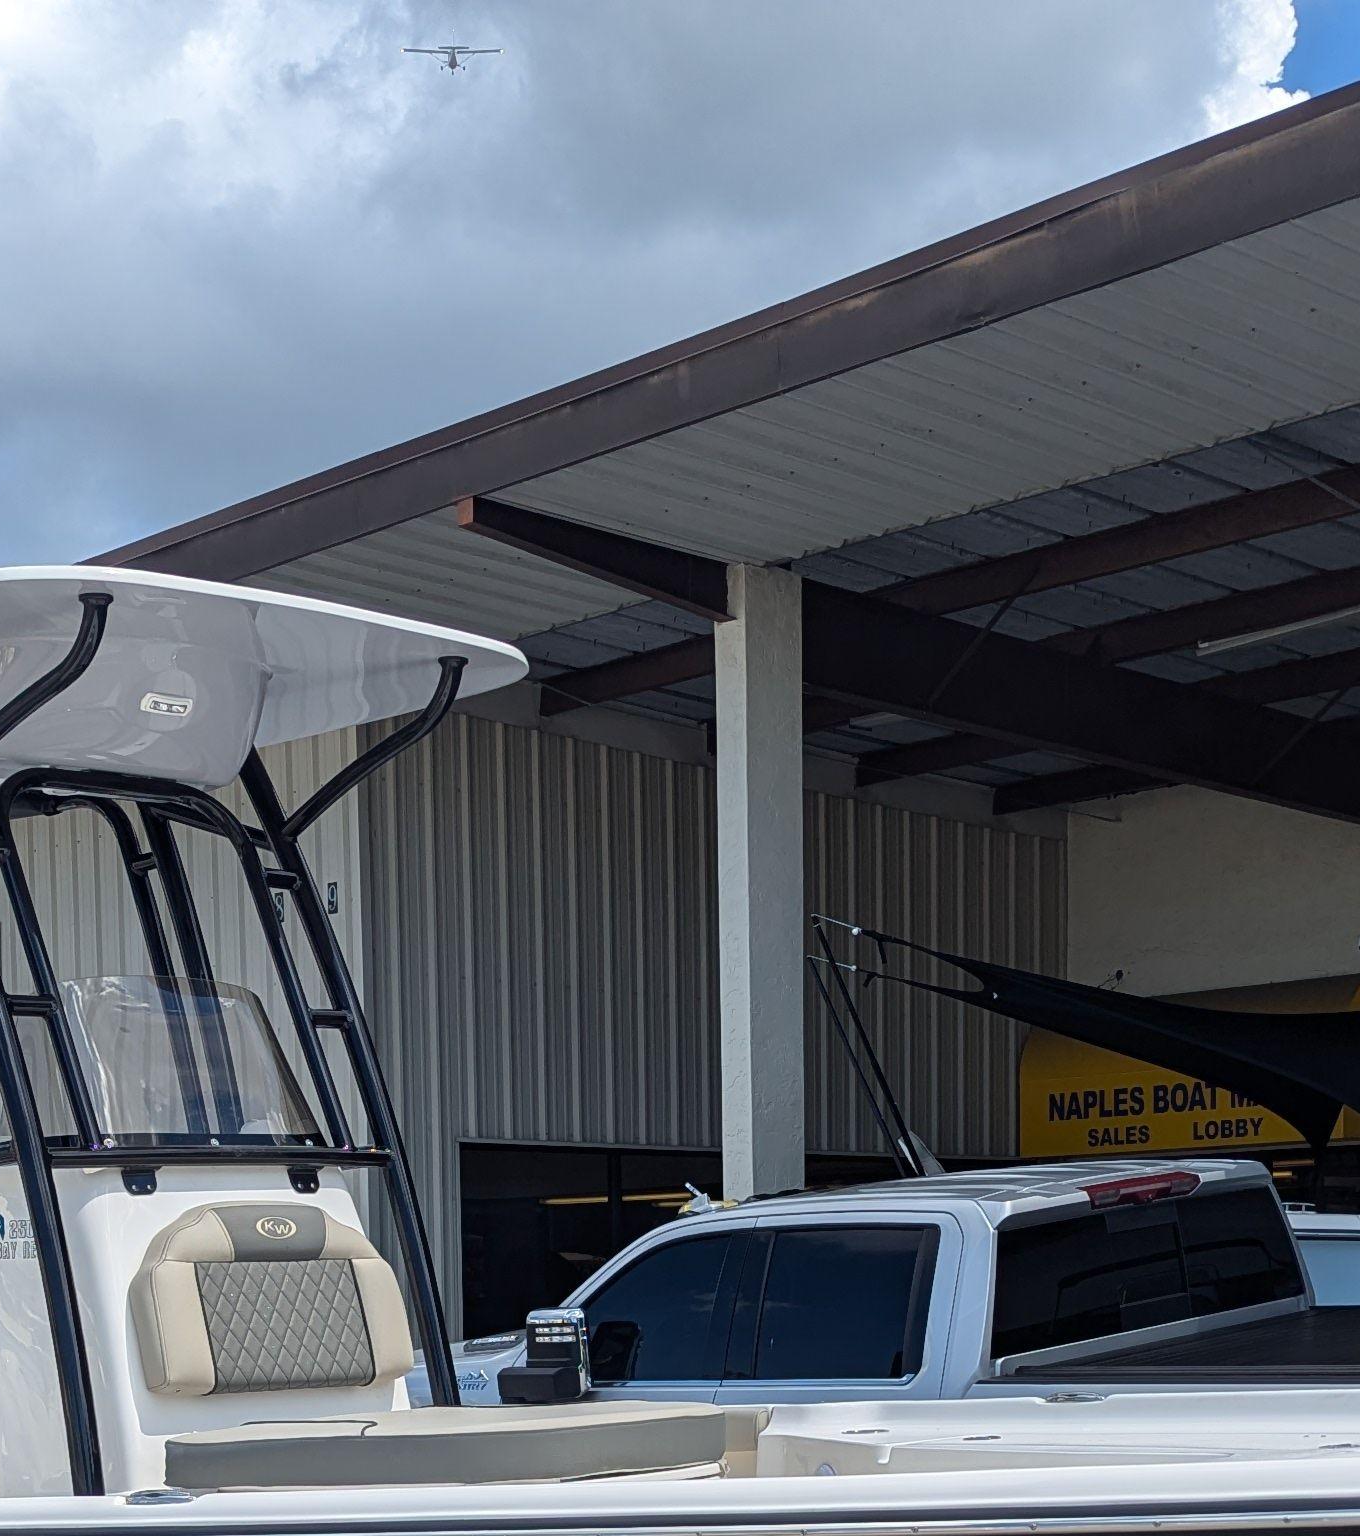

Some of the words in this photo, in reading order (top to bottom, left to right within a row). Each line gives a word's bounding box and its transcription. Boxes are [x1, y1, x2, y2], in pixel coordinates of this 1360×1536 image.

[328, 885, 337, 911] 9
[1048, 1086, 1145, 1121] NAPLES
[1153, 1081, 1218, 1114] BOAT
[1087, 1124, 1151, 1147] SALES
[1192, 1117, 1264, 1141] LOBBY
[264, 1220, 290, 1235] KW
[22, 1240, 38, 1260] RE
